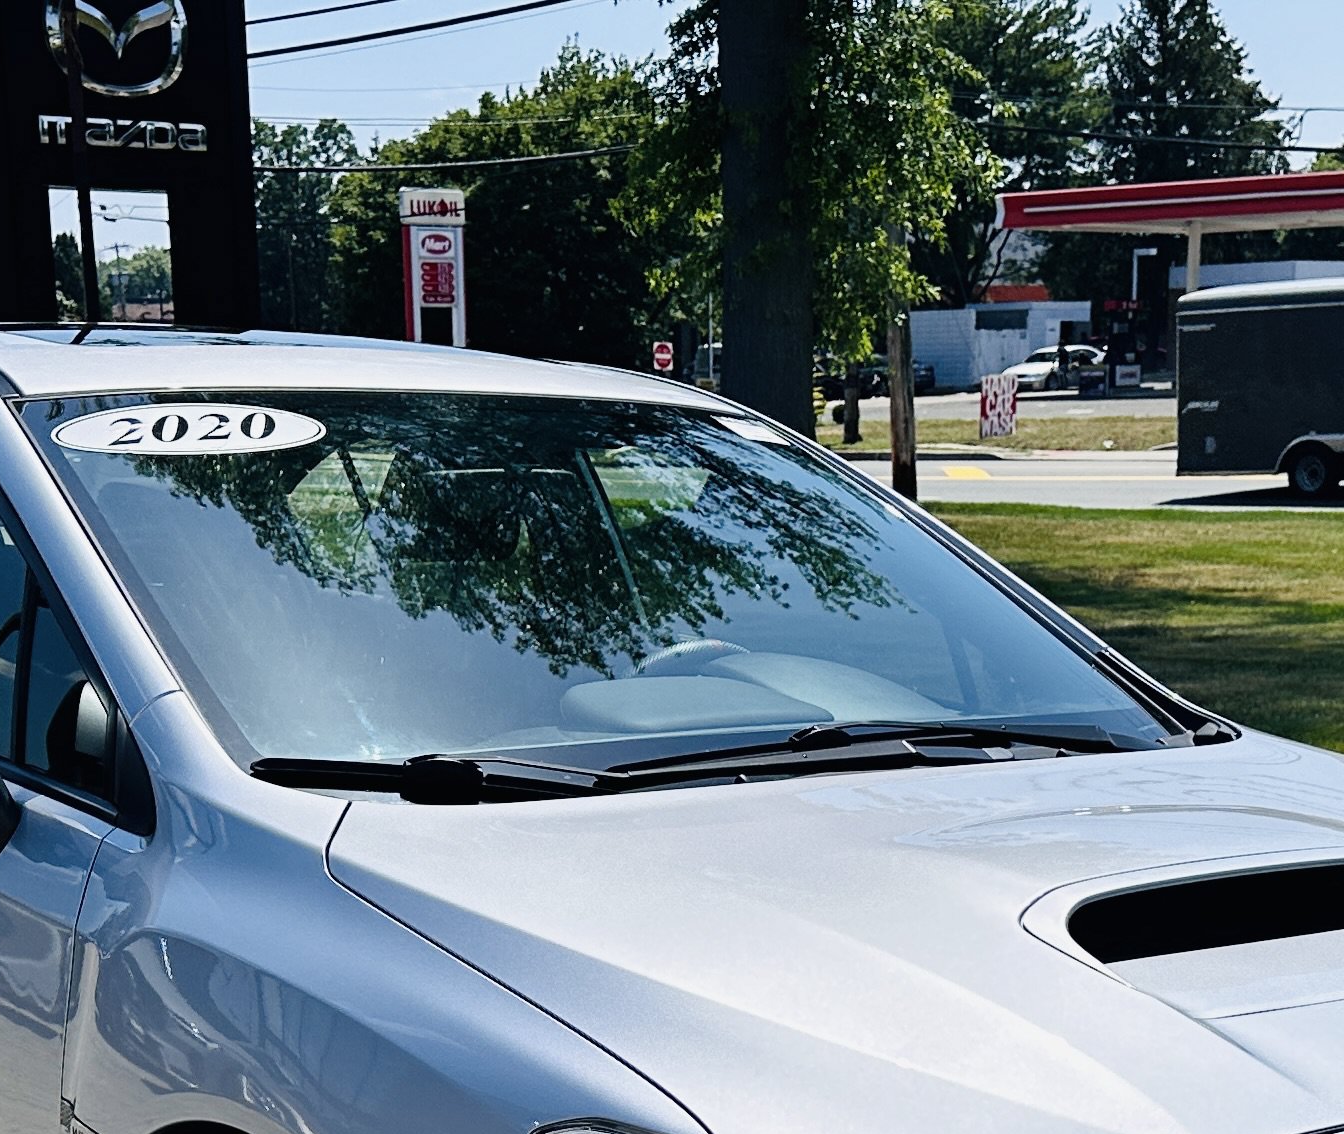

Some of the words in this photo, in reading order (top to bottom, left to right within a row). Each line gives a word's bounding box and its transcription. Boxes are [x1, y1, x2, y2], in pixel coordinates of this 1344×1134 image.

[410, 198, 461, 217] LUKOIL
[981, 375, 1018, 398] HAND
[985, 393, 1014, 416] CAR
[108, 412, 276, 446] 2020
[981, 414, 1017, 437] WASH
